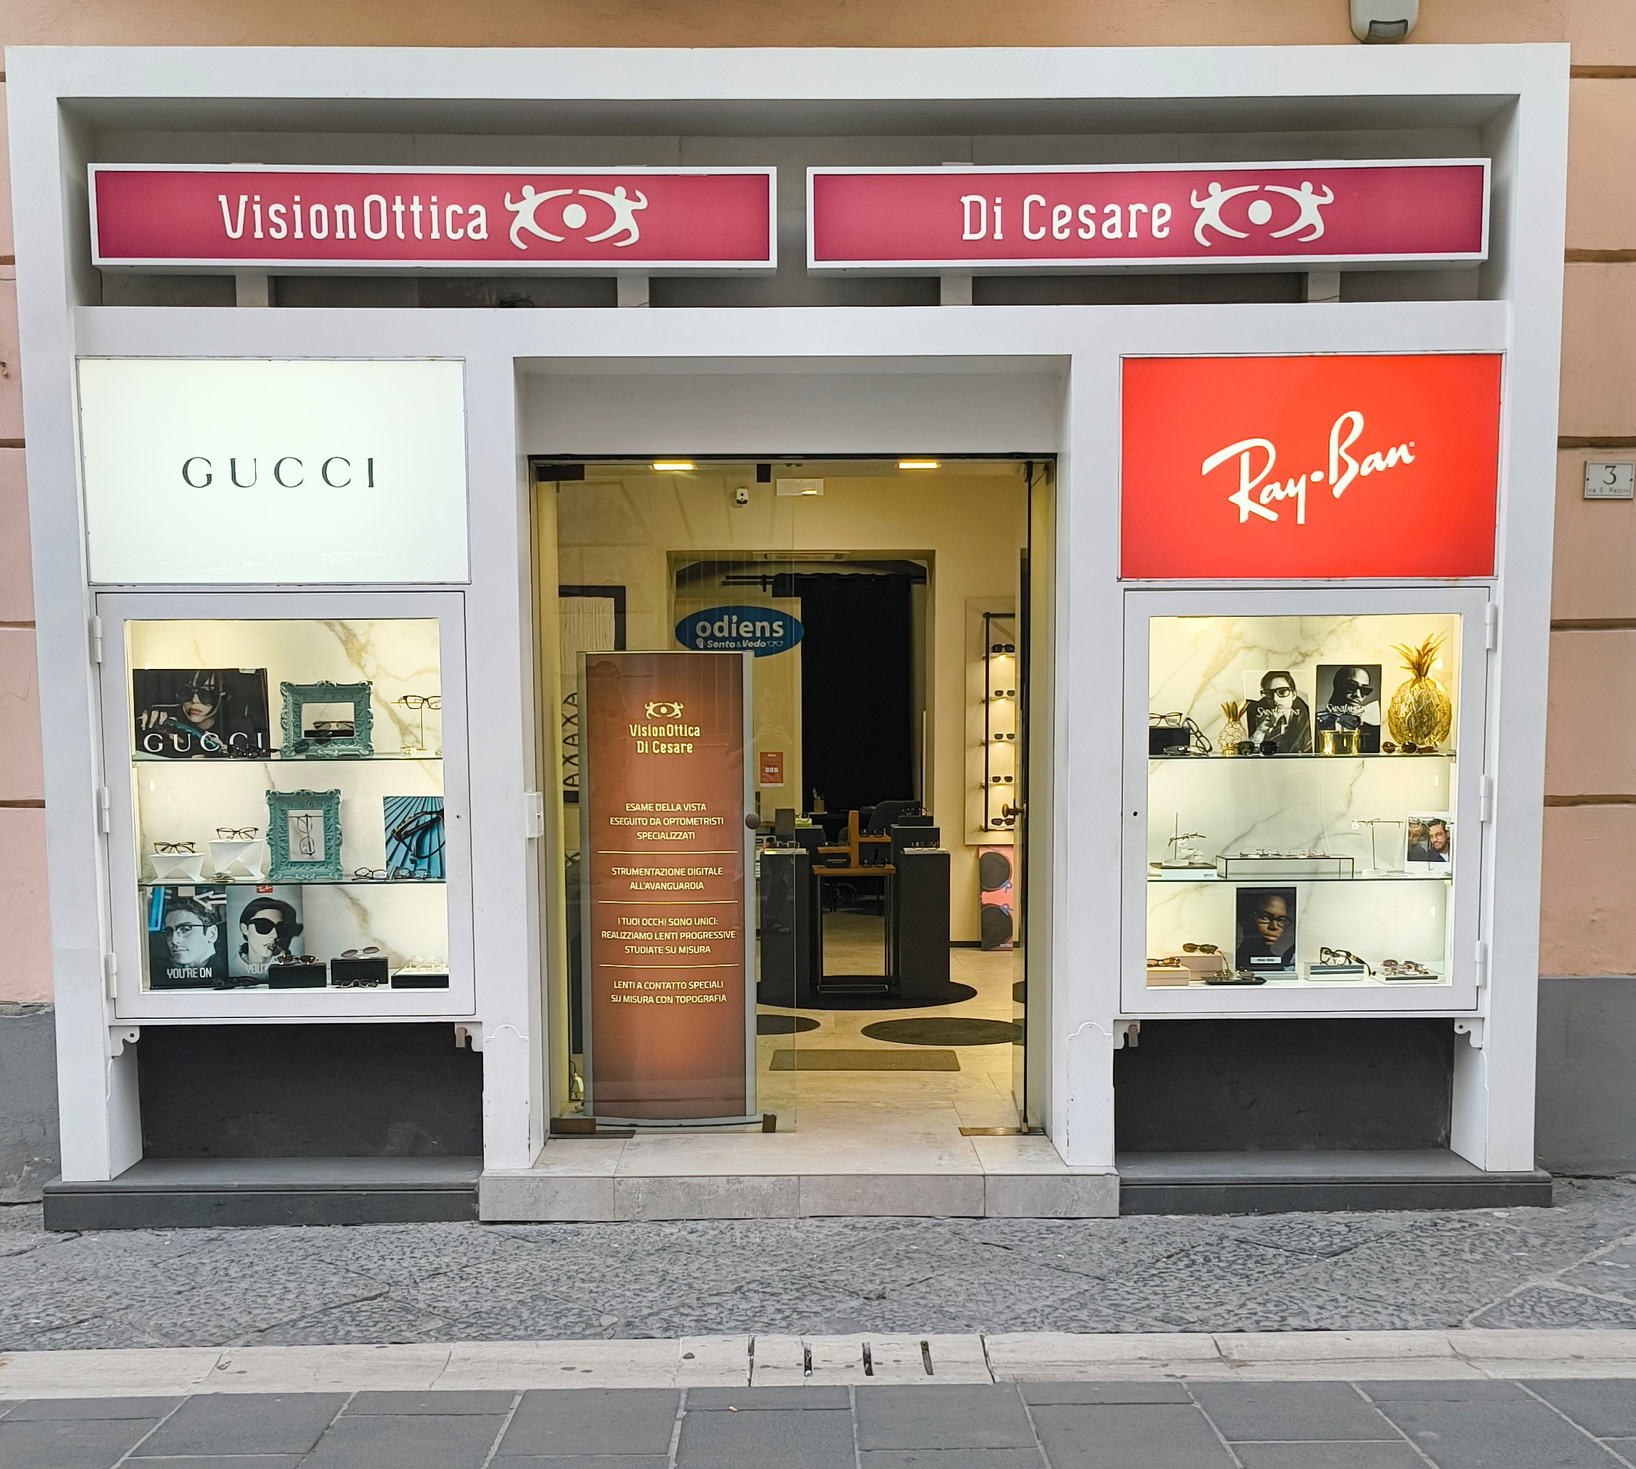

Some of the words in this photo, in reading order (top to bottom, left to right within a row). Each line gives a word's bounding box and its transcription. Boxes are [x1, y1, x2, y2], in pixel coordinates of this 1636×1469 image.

[217, 193, 489, 240] VisionOttica
[960, 194, 1003, 241] Di
[1022, 193, 1173, 240] Cesare
[182, 456, 376, 489] GUCCI
[1603, 465, 1617, 485] 3
[695, 615, 784, 637] odiens
[629, 724, 701, 737] VisionOttica
[636, 740, 649, 754] Di
[652, 740, 693, 754] Cesare
[626, 803, 654, 812] ESAME
[656, 803, 682, 812] DELLA
[683, 803, 706, 812] VISTA
[610, 817, 648, 826] ESEGUITO
[650, 818, 662, 826] DA
[663, 817, 724, 826] OPTOMETRISTI
[636, 832, 696, 840] SPECIALIZZATI
[612, 867, 686, 876] STRUMENTAZIONE
[688, 867, 724, 876] DIGITALE
[630, 882, 704, 890] ALL'AVANGUARDIA
[622, 918, 640, 926] TUOI
[642, 918, 666, 926] OCCHI
[668, 918, 692, 926] SONO
[602, 931, 652, 940] REALIZZIAMO
[654, 932, 678, 940] LENTI
[680, 931, 736, 940] PROGRESSIVE
[624, 946, 663, 954] STUDIATE
[665, 946, 677, 954] SU
[678, 946, 711, 954] MISURA
[166, 968, 198, 979] YOU'RE
[200, 967, 212, 978] ON
[614, 980, 636, 989] LENTI
[636, 981, 643, 989] A
[644, 981, 686, 990] CONTATTO
[688, 980, 724, 990] SPECIALI
[610, 994, 622, 1002] SU
[623, 995, 654, 1004] MISURA
[656, 995, 674, 1004] CON
[675, 994, 727, 1004] TOPOGRAFIA
